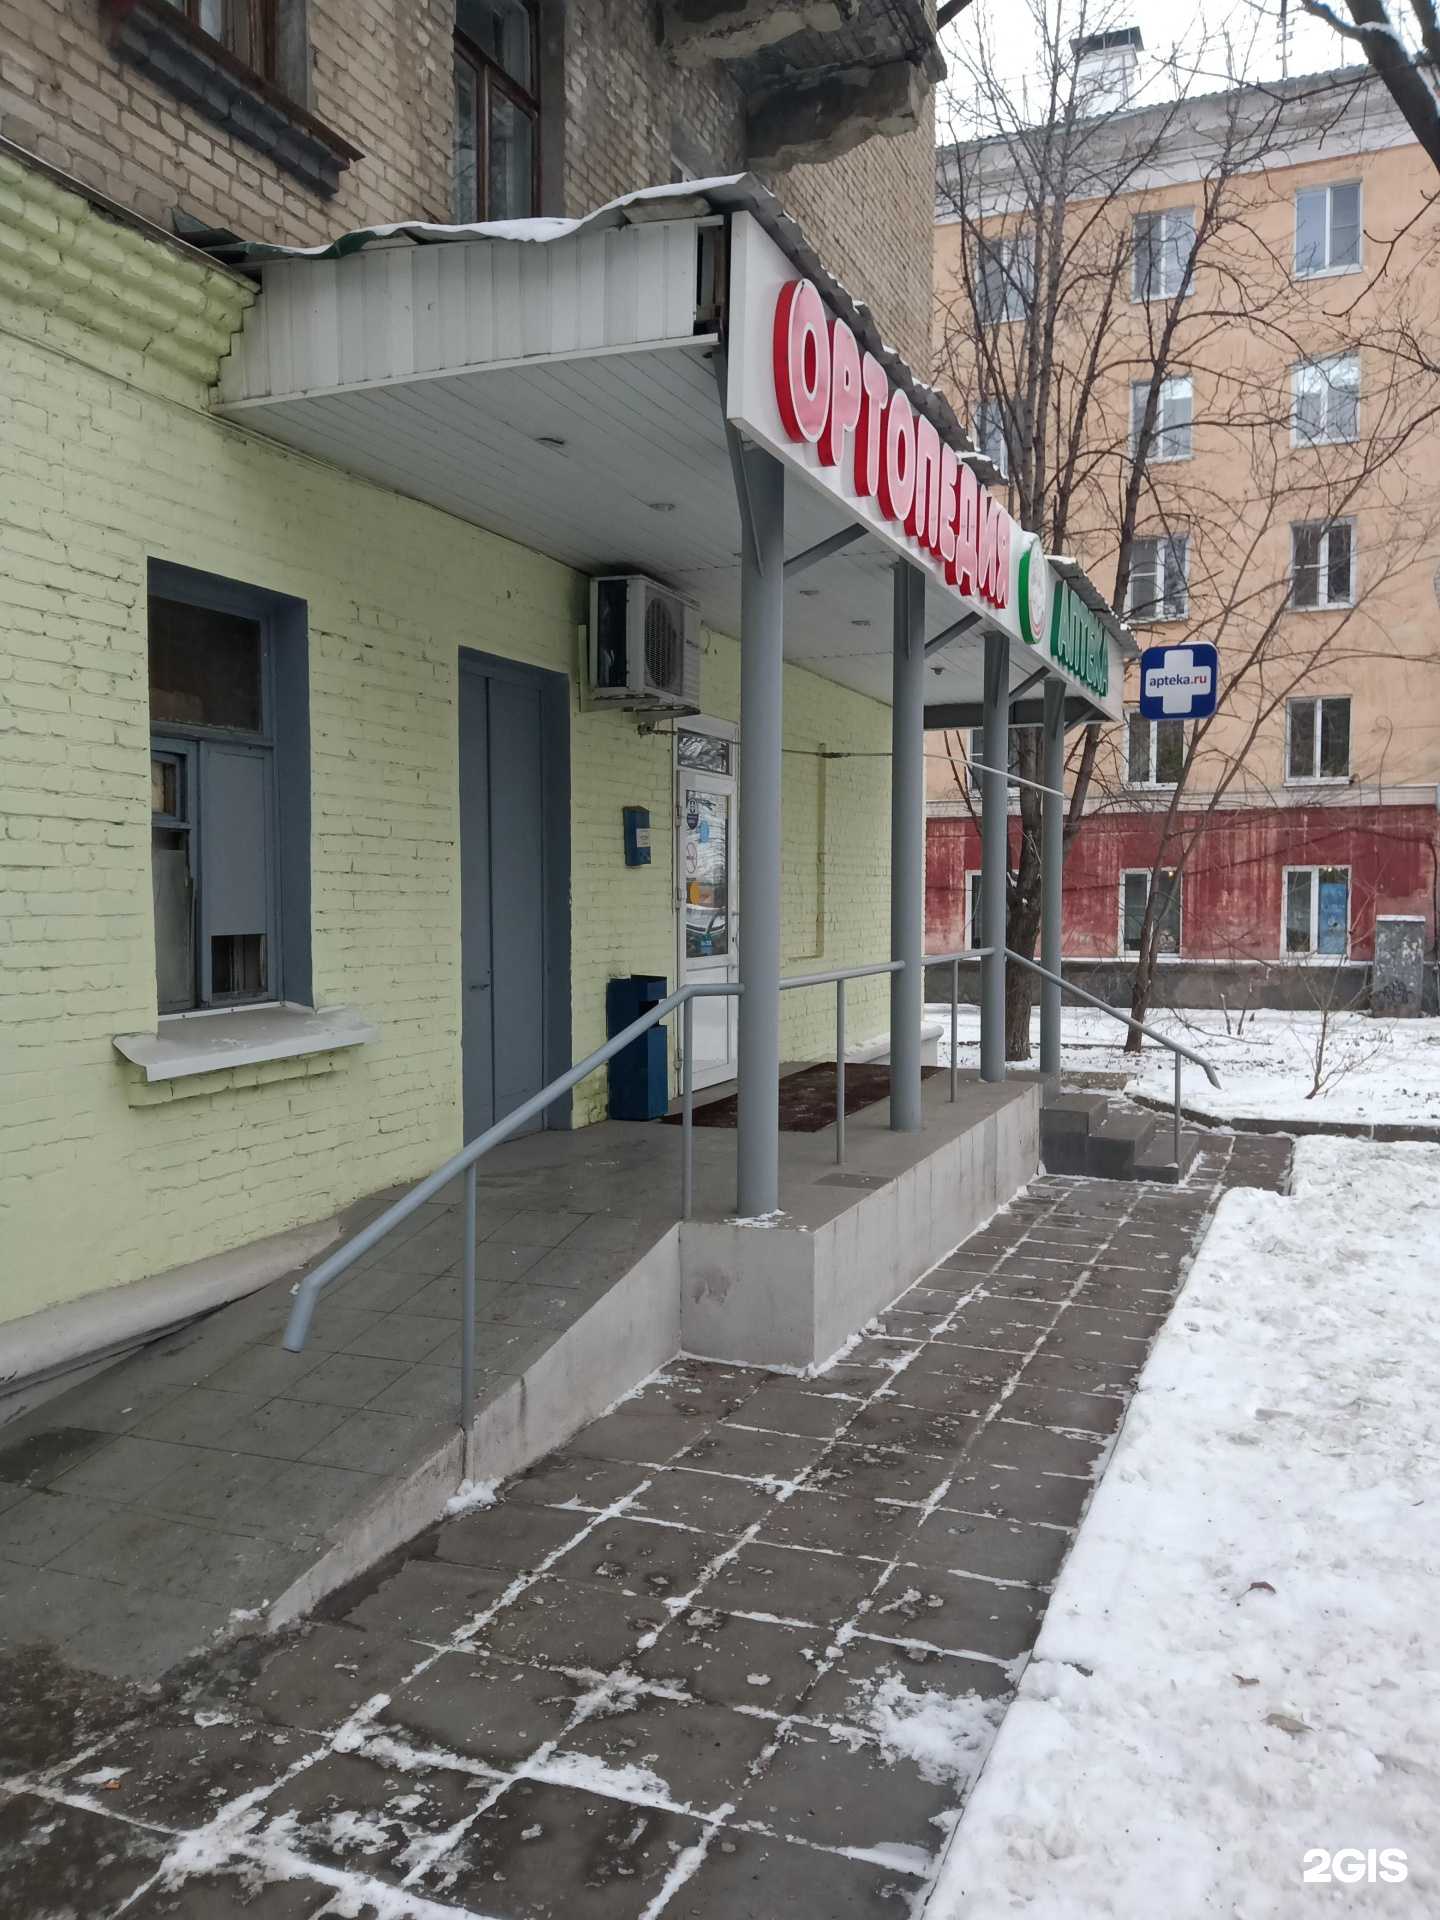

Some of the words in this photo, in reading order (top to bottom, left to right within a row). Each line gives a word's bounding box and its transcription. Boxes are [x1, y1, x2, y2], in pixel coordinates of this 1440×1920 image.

[773, 278, 1011, 609] ОРТОПЕДИЯ
[1050, 580, 1109, 697] АПТЕКА
[1149, 674, 1207, 688] apteka.ru
